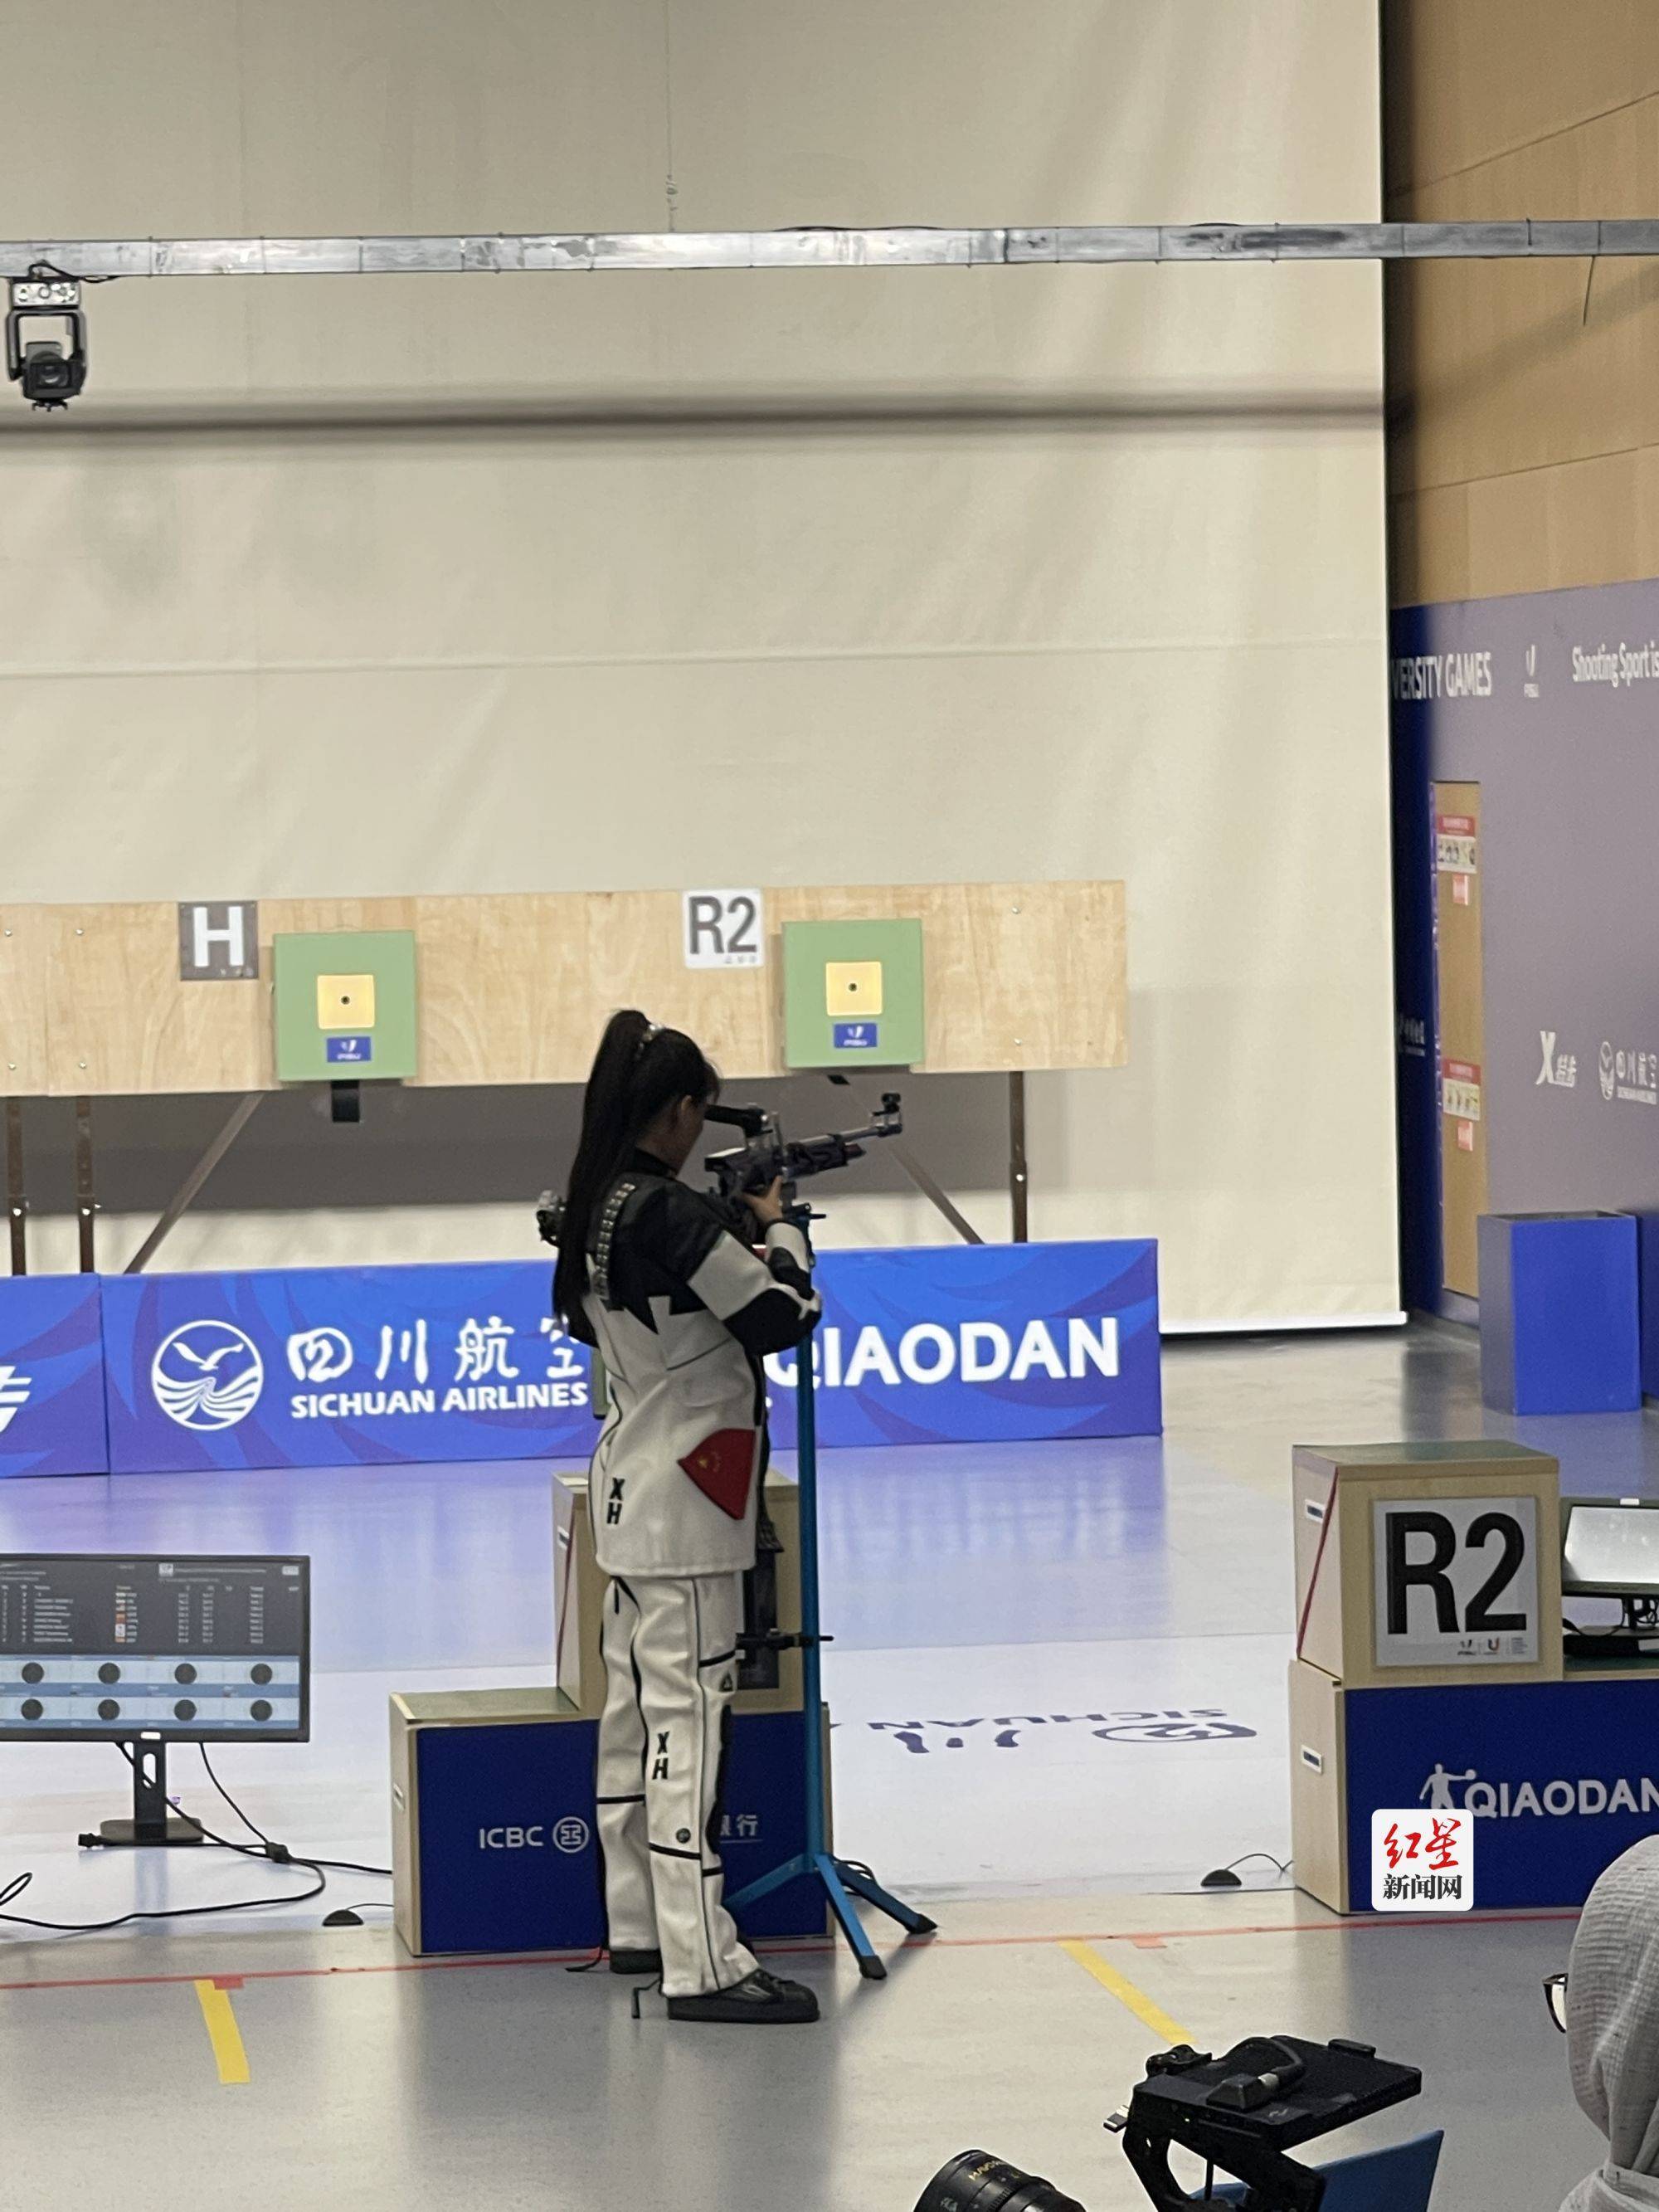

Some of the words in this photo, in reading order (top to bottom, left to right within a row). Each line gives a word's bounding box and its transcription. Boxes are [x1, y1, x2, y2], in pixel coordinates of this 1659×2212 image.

[1446, 650, 1491, 698] GAMES
[1572, 644, 1618, 688] Shooting
[193, 906, 244, 967] H
[688, 895, 757, 955] R2
[287, 1315, 585, 1383] 四川航空
[291, 1389, 435, 1419] SICHUAN
[441, 1381, 589, 1412] AIRLINES
[1386, 1511, 1527, 1635] R2
[1464, 1777, 1659, 1819] QIAODAN
[479, 1826, 544, 1849] ICBC
